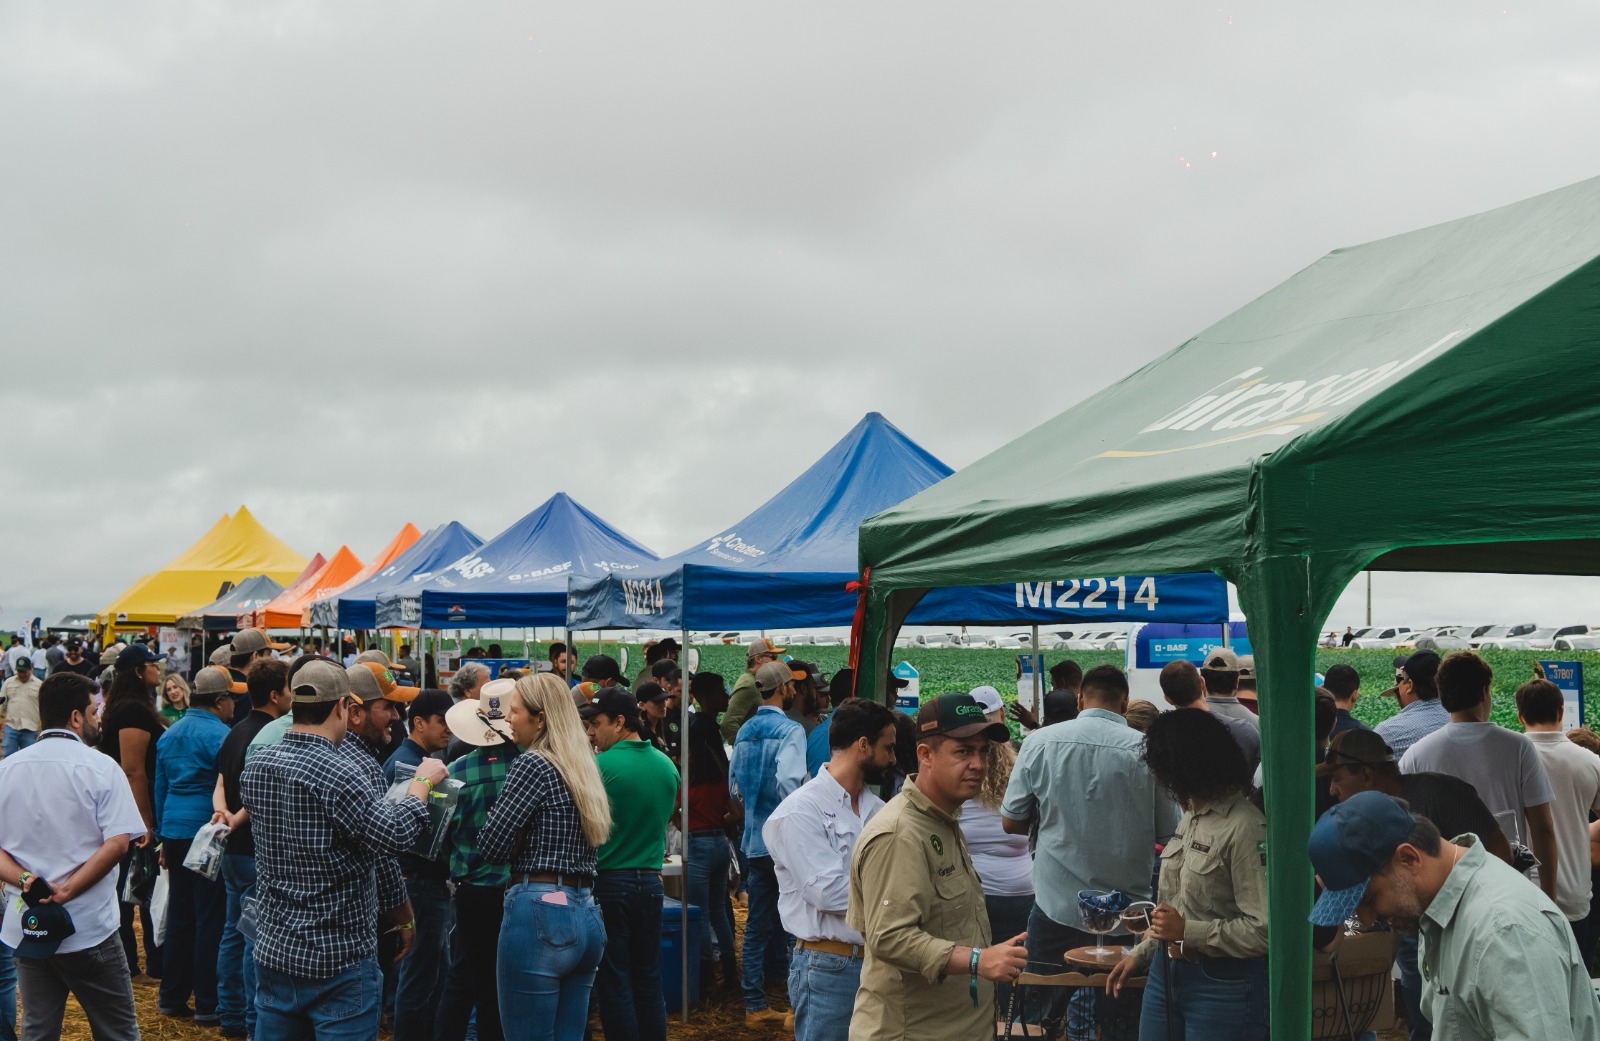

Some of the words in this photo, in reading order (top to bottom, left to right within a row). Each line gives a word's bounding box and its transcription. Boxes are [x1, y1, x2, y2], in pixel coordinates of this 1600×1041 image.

[531, 561, 572, 578] BASF
[621, 578, 664, 615] M2214
[1015, 575, 1159, 611] M2214
[1166, 643, 1188, 652] BASF
[1554, 668, 1574, 680] 37B07
